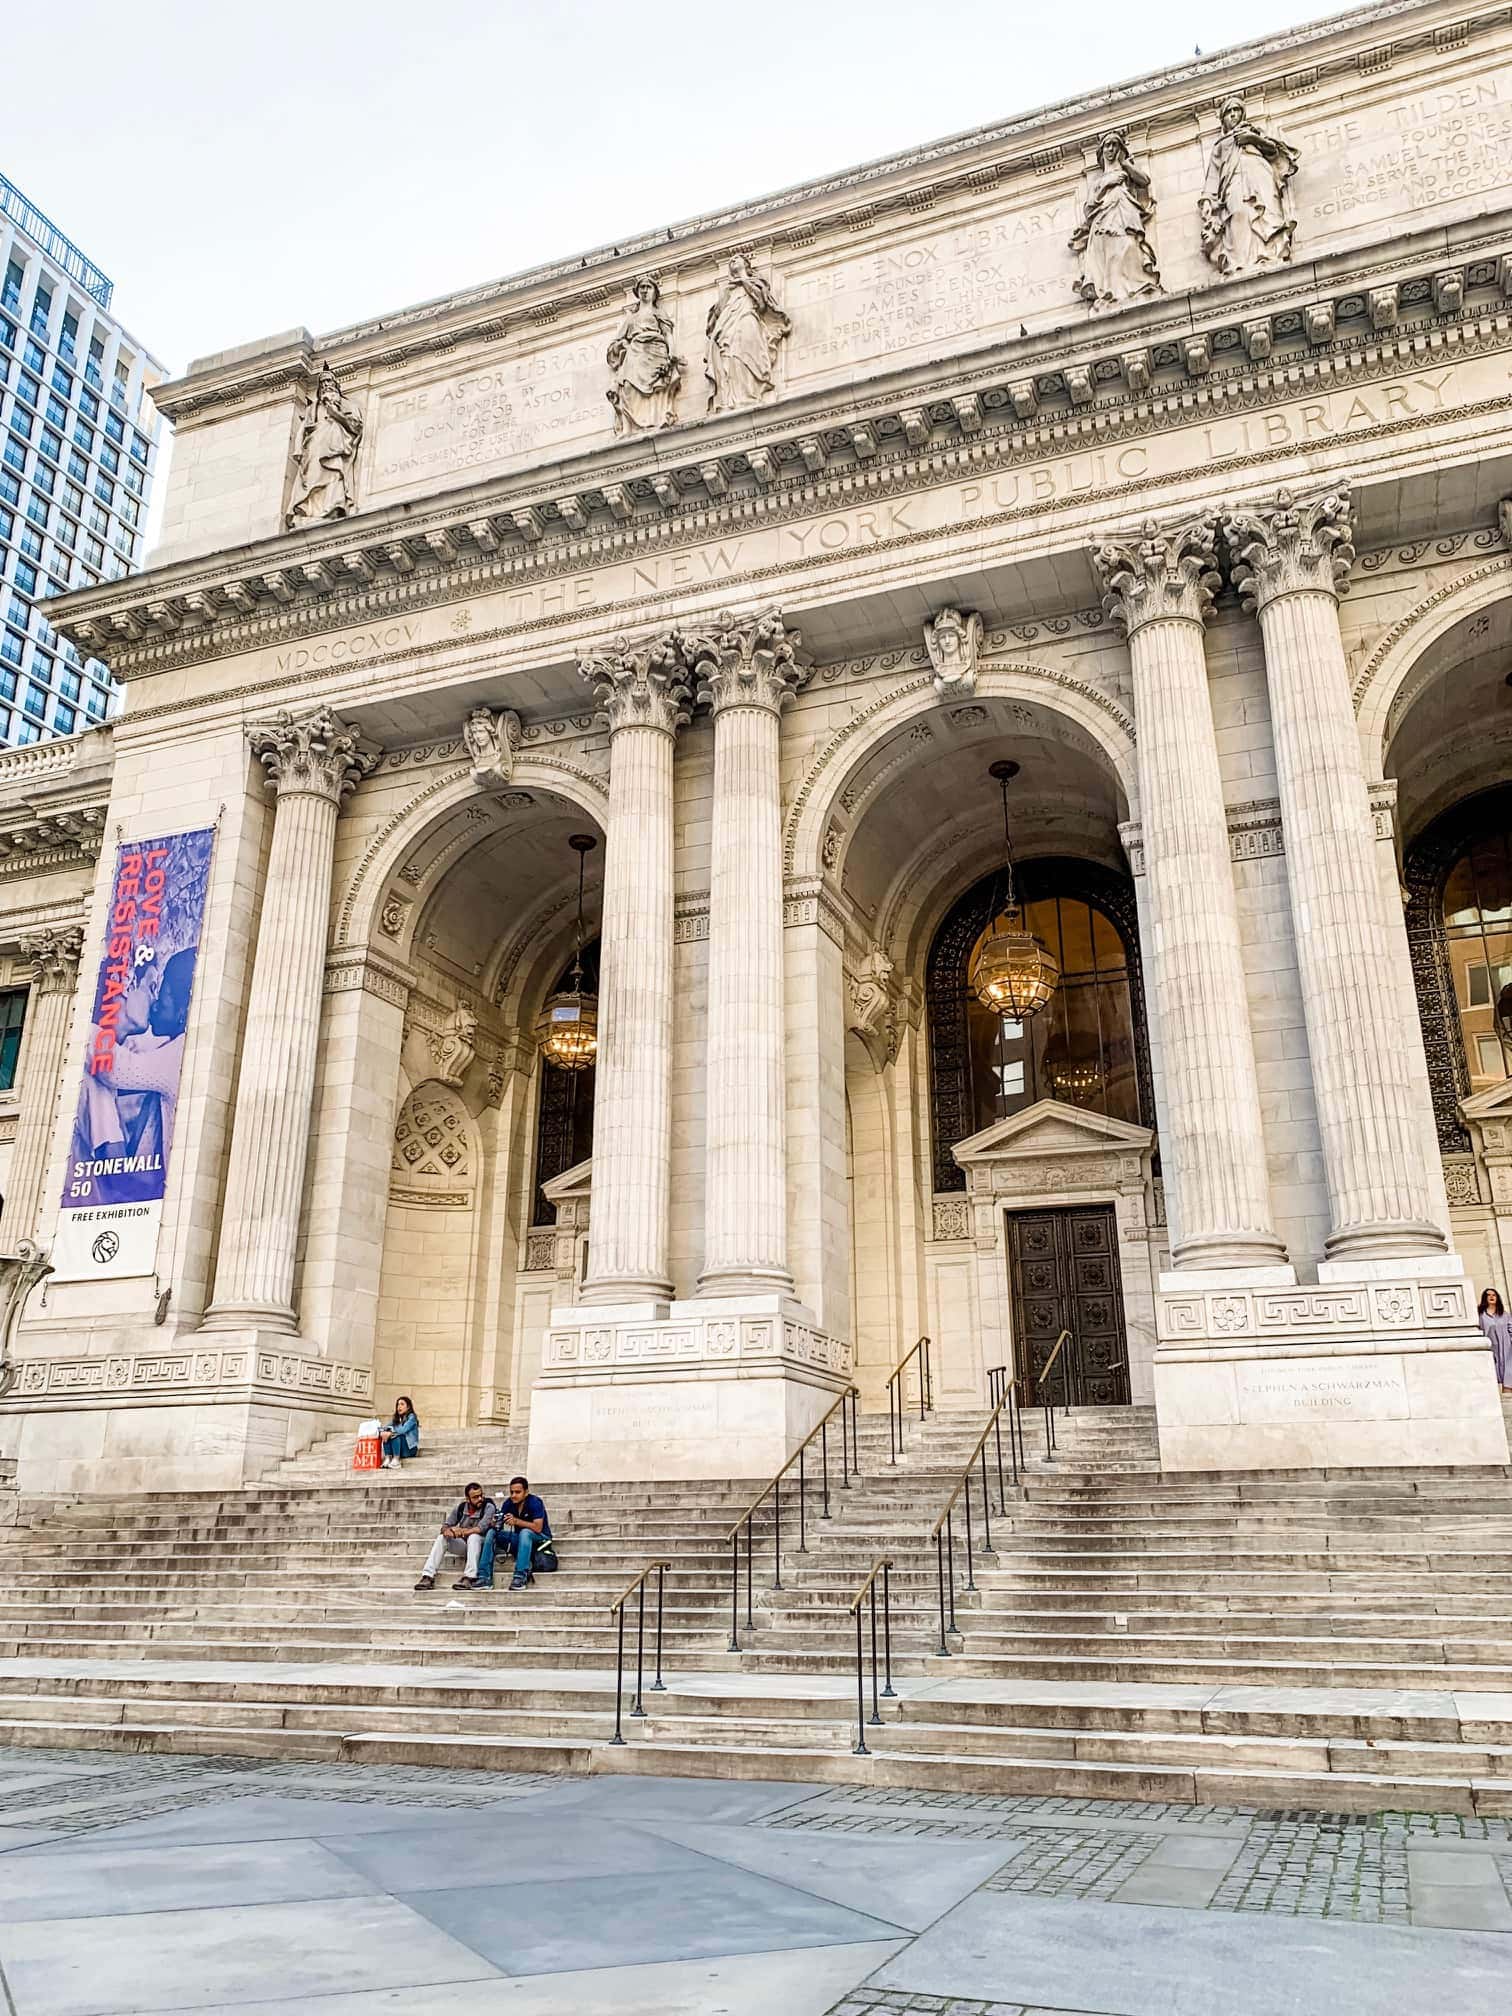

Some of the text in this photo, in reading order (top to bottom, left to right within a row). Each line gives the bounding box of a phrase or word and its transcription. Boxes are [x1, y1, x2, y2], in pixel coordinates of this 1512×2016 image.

[1304, 80, 1498, 153] THE TILDEN
[1400, 112, 1489, 146] FOUNDED
[1344, 119, 1512, 179] SAMUEL JONES
[1368, 163, 1420, 188] SERVE
[1432, 150, 1469, 169] THE
[1313, 188, 1391, 218] SCIENCE
[1400, 175, 1437, 195] AND
[800, 271, 847, 299] THE
[954, 208, 1060, 256] LIBRARY
[856, 264, 1003, 317] JAMES LENOX
[875, 256, 982, 297] FOUNDED BY
[798, 278, 1067, 360] LITERATURE AND THE FINE ARTS
[834, 274, 1028, 337] DEDICATED TO HISTORY
[391, 341, 602, 418] THE ASTOR LIBRARY
[414, 387, 571, 442] JOHN JACOB ASTOR
[450, 393, 508, 416] FOUNDED
[469, 438, 487, 452] OF
[534, 405, 607, 434] KNOWLEDGE
[273, 370, 1457, 675] MDCCCXCV THE NEW YORK PUBLIC LIBRARY
[133, 847, 168, 967] LOVE &
[90, 852, 143, 1076] RESISTANCE
[74, 1154, 162, 1178] STONEWALL
[70, 1180, 92, 1198] 50
[72, 1207, 151, 1222] FREE EXHIBITION
[1293, 1396, 1352, 1408] BUILDING
[1311, 1379, 1401, 1392] SCHWARZMAN
[354, 1453, 377, 1468] MET
[358, 1440, 377, 1454] THE
